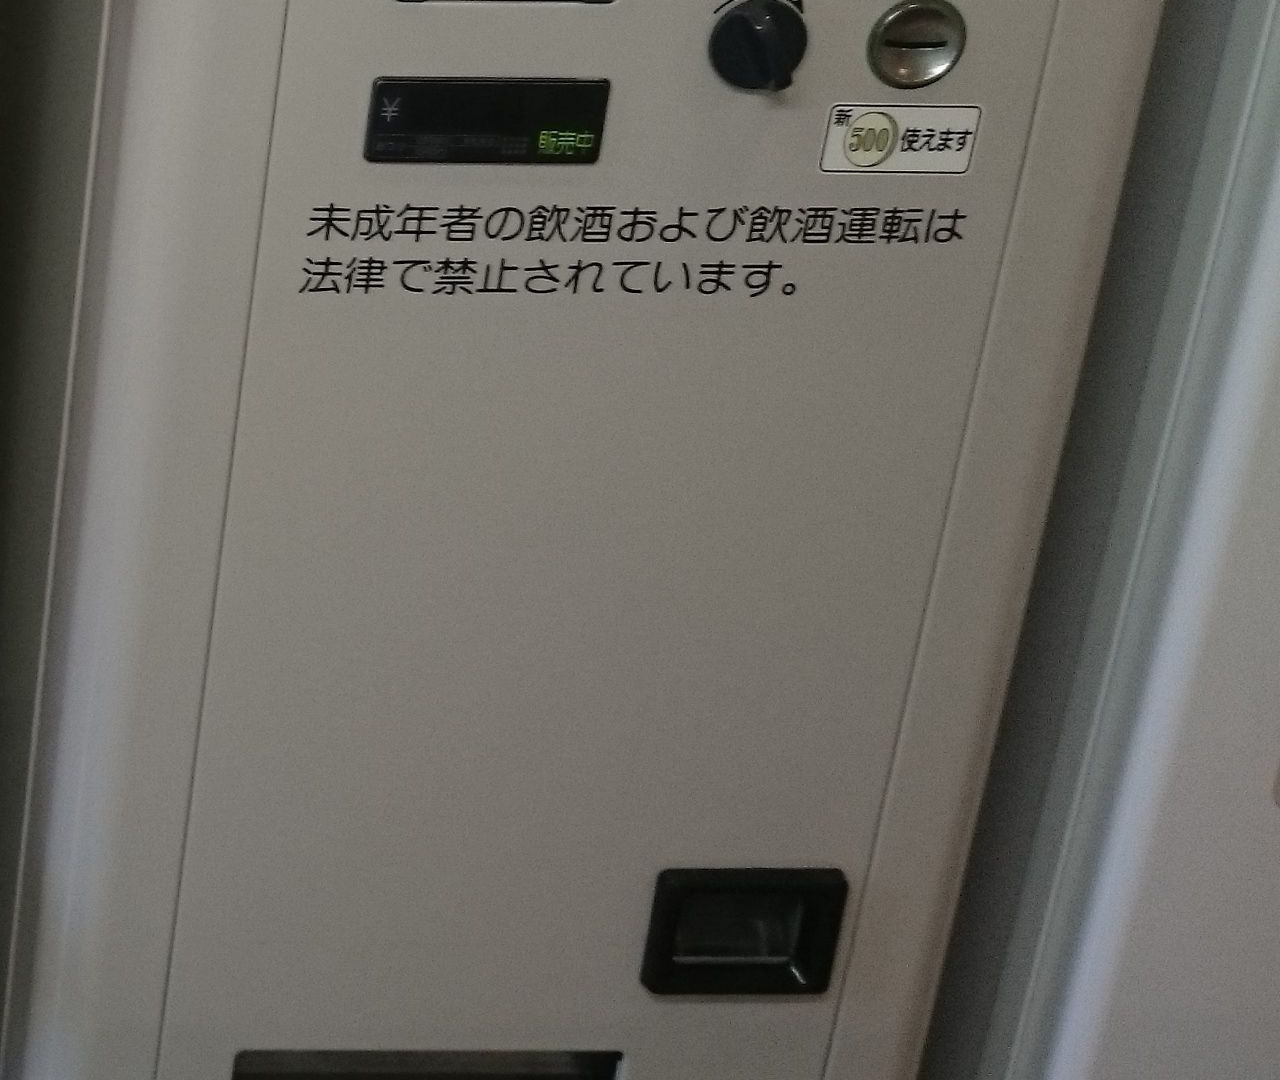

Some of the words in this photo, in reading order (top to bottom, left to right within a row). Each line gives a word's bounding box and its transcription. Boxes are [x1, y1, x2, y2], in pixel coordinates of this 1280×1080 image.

[833, 109, 852, 126] 新
[848, 127, 887, 153] 500
[900, 127, 974, 153] 使えます
[306, 204, 968, 245] 未成年者の飲酒および飲酒運転は
[297, 258, 801, 297] 法律で禁止されています。
